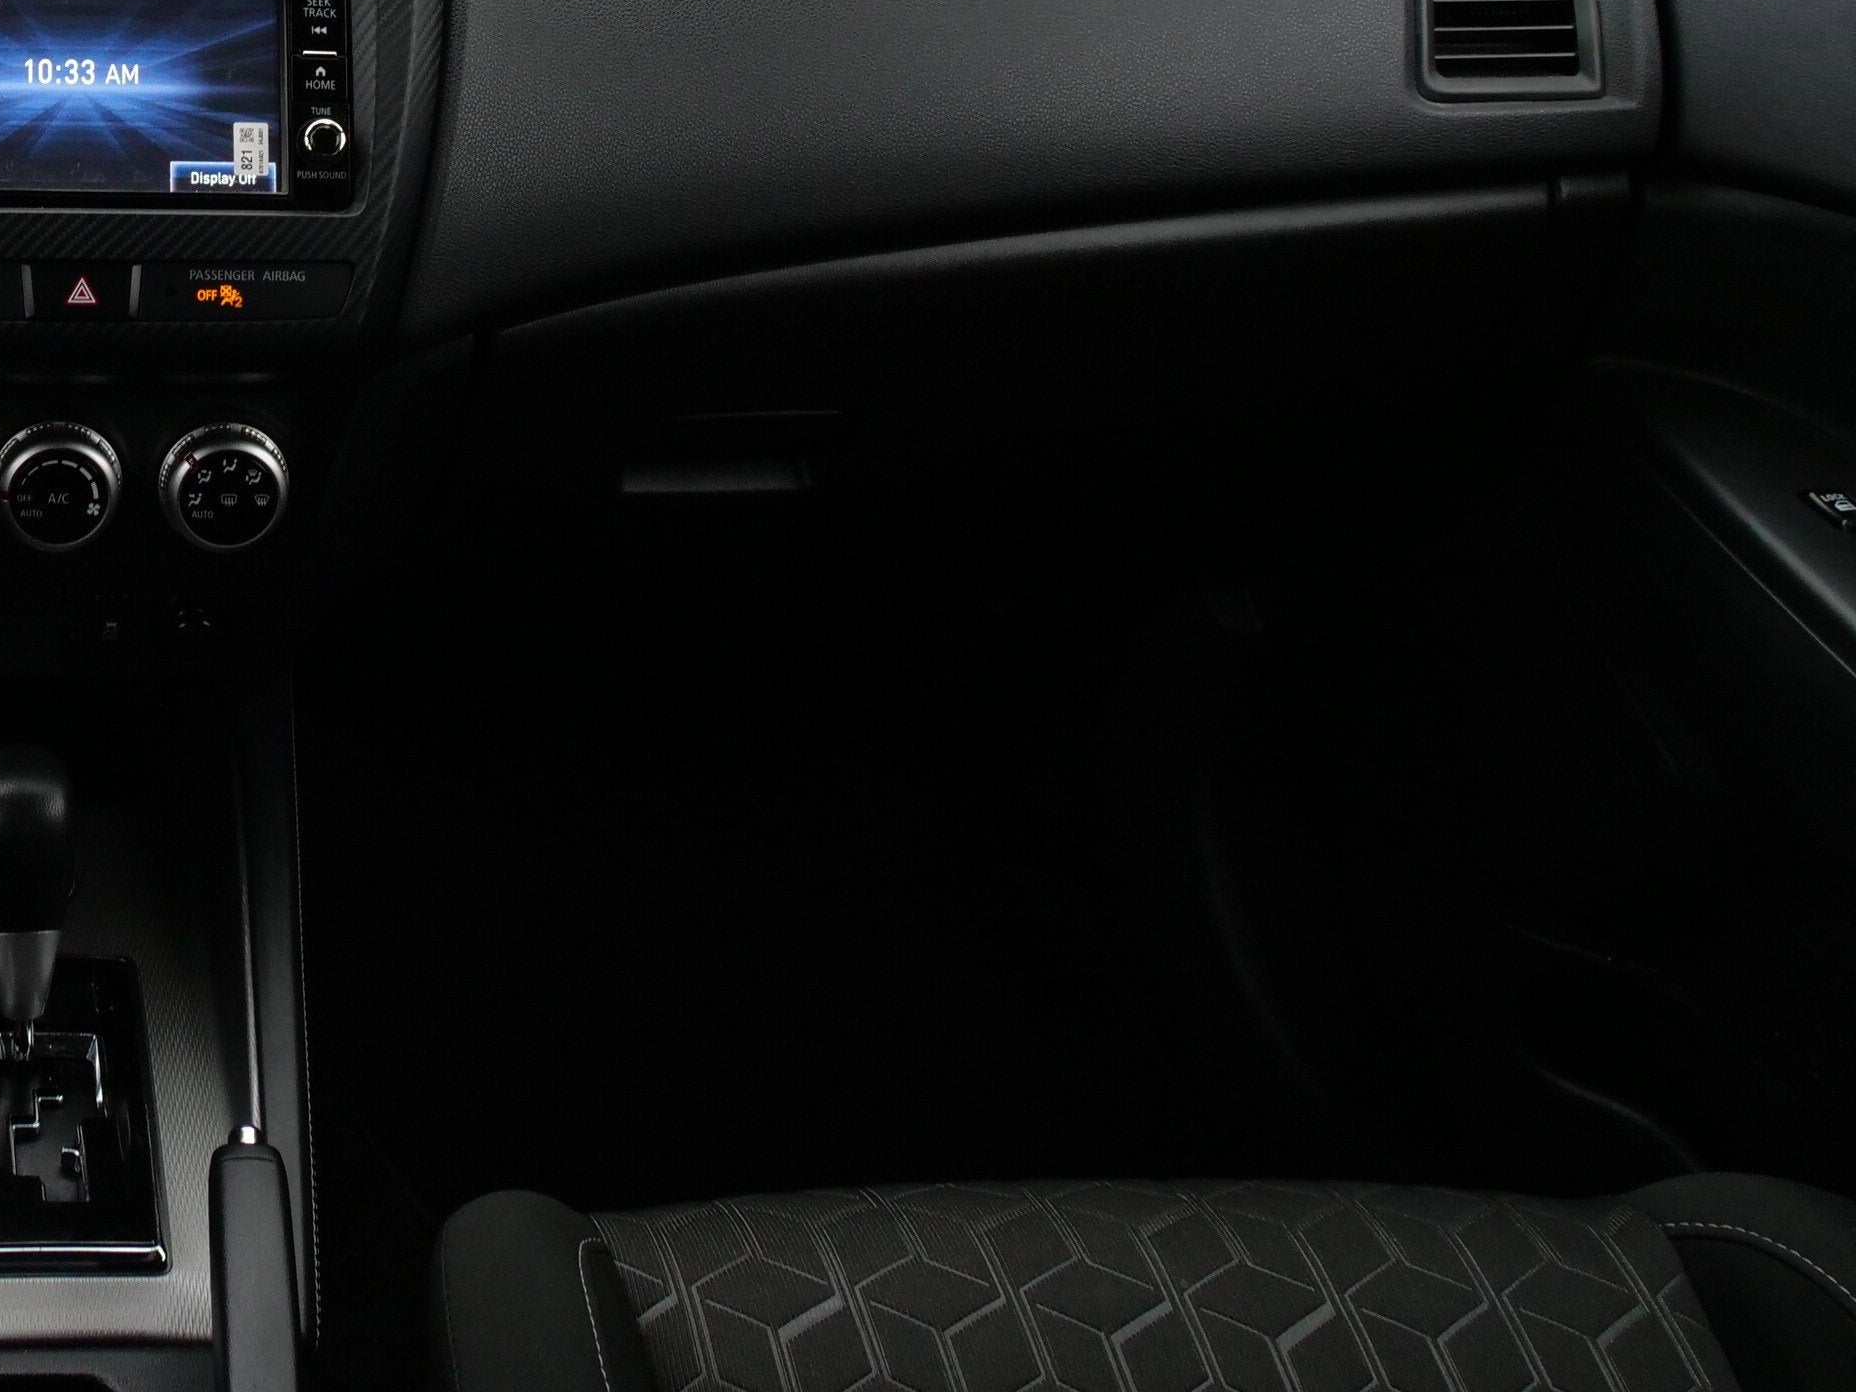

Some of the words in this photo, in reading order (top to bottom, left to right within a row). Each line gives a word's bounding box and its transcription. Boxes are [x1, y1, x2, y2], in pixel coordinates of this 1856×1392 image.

[303, 8, 337, 19] TRACK
[24, 58, 96, 85] 10:33
[105, 63, 140, 85] AM
[305, 80, 336, 91] HOME
[311, 107, 331, 116] TUNE
[240, 149, 253, 171] 821
[190, 171, 236, 187] Display
[297, 170, 318, 180] PUSH
[319, 170, 347, 180] SOUND
[189, 270, 256, 281] PASSENGER
[262, 270, 306, 282] AIRBAG
[197, 289, 218, 301] OFF
[16, 494, 33, 503] OFF
[48, 493, 70, 505] A/C
[20, 509, 43, 518] AUTO
[191, 510, 214, 519] AUTO
